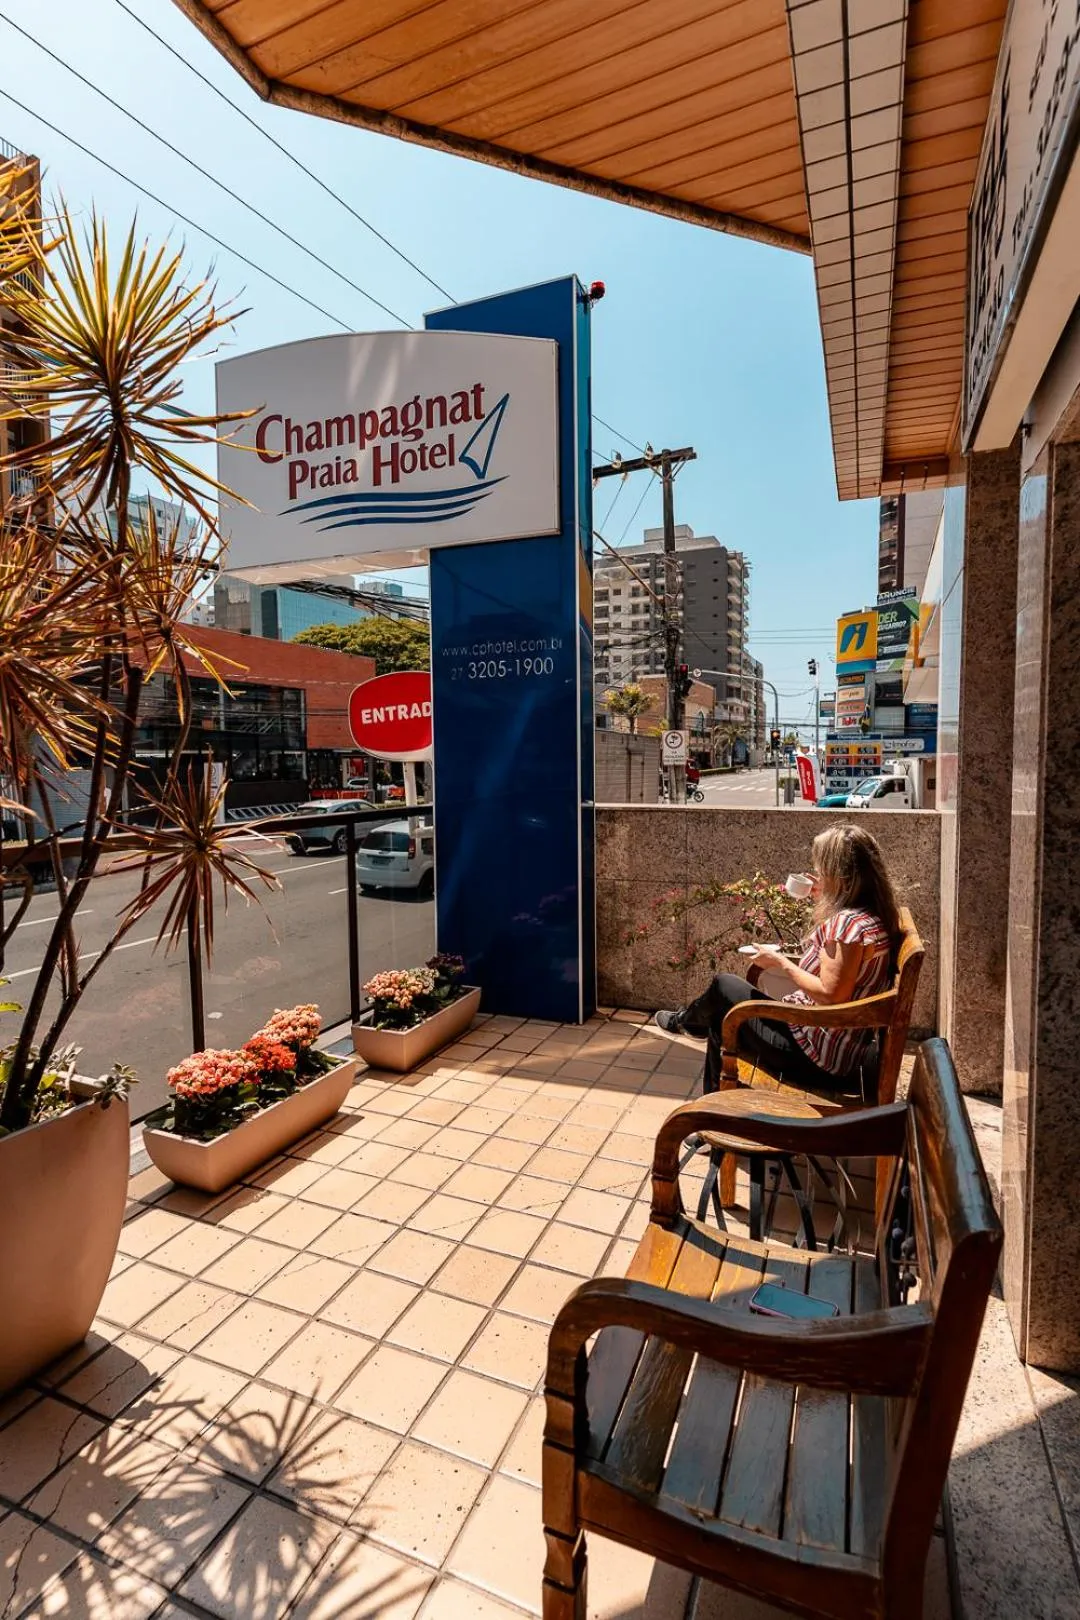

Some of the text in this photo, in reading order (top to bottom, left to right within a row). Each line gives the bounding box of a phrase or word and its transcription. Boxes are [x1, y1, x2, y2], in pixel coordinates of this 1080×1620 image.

[256, 383, 485, 463] Champagnat
[288, 433, 455, 500] Praia Hotel
[468, 656, 554, 679] 3205-1900
